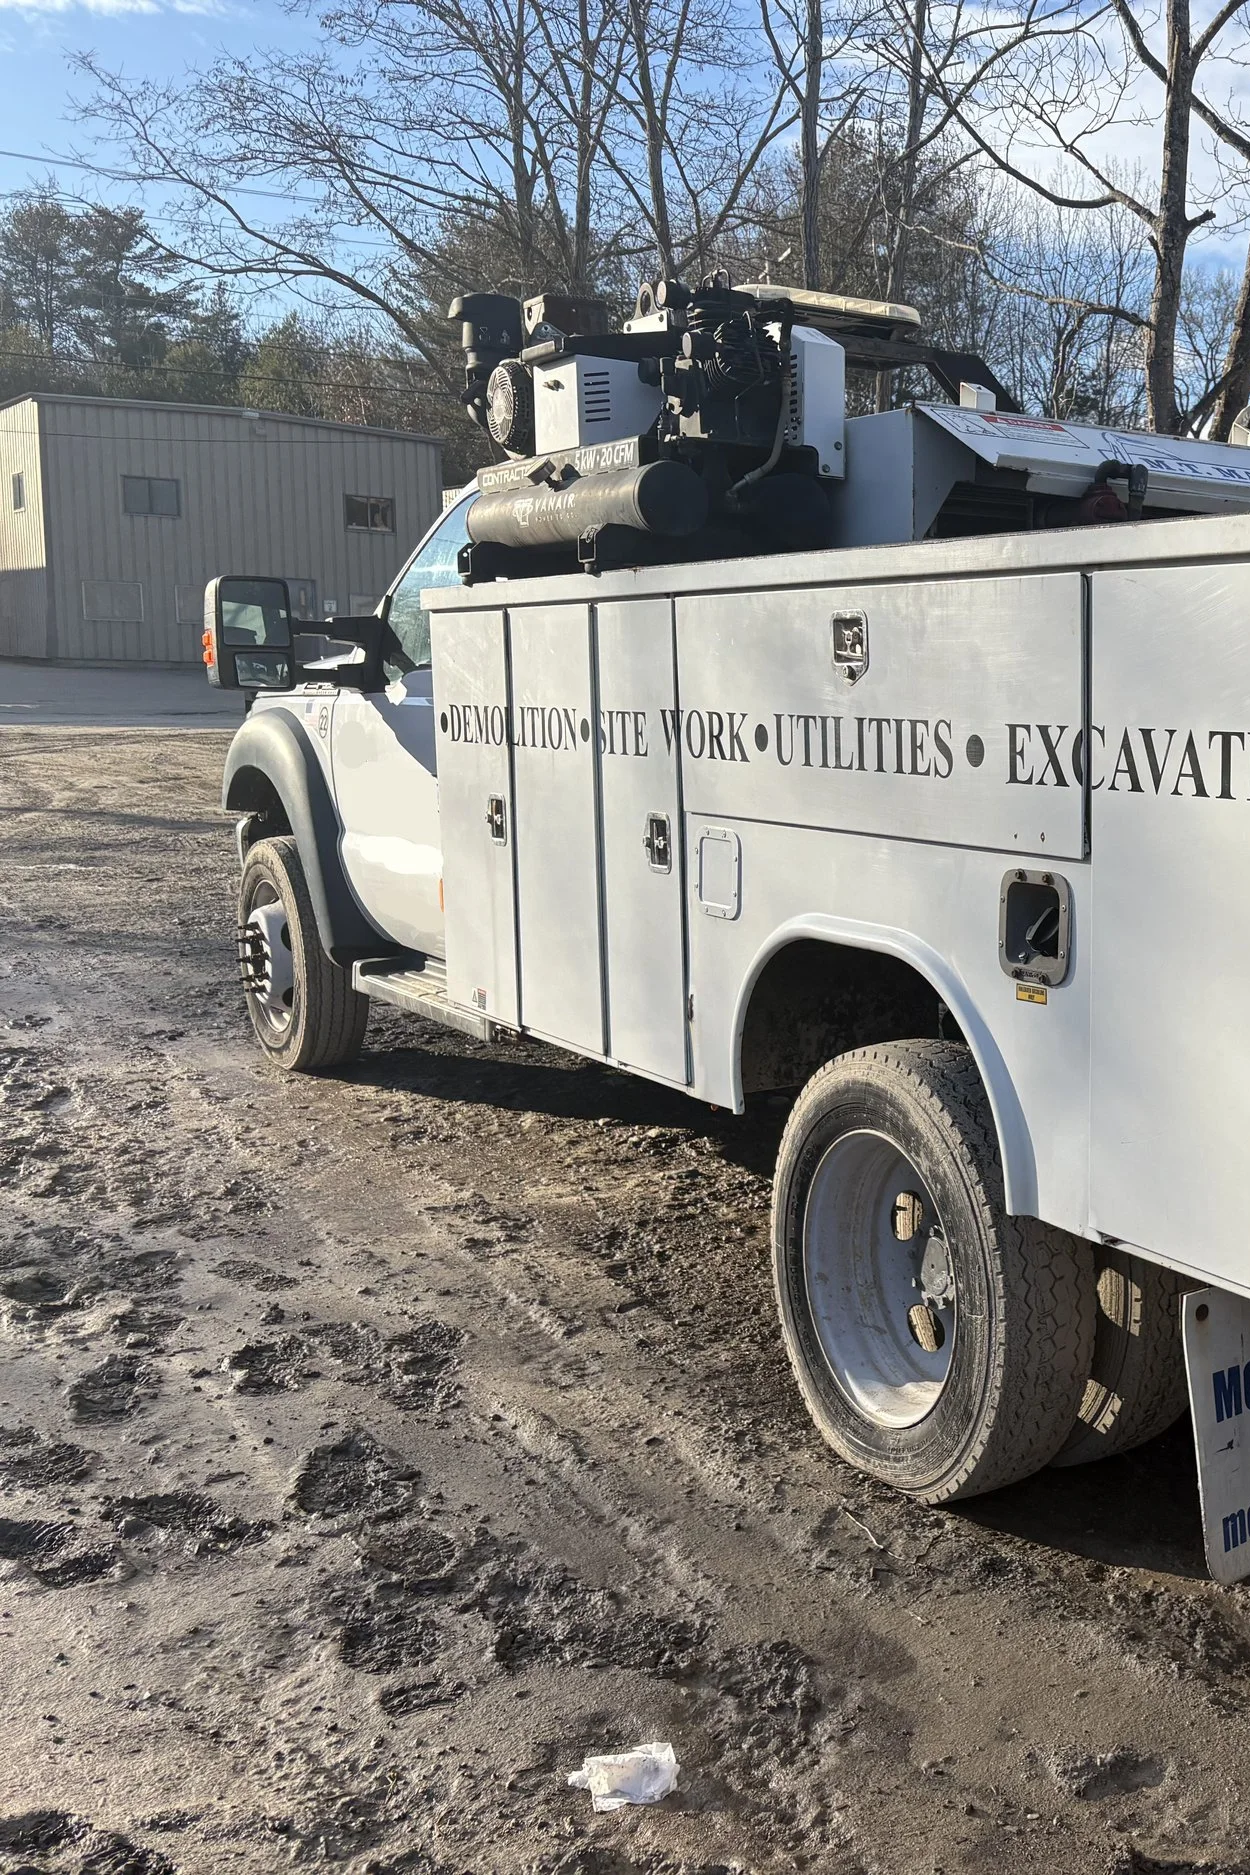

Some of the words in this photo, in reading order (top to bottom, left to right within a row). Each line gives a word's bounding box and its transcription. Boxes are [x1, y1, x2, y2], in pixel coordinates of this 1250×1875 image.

[575, 450, 580, 470] 5
[600, 447, 612, 467] 20
[613, 442, 634, 465] CFM
[535, 493, 574, 513] VANAIR
[449, 704, 577, 751] DEMOLITION
[599, 709, 649, 757] SITE
[660, 708, 750, 763] WORK
[773, 713, 953, 780] UTILITIES
